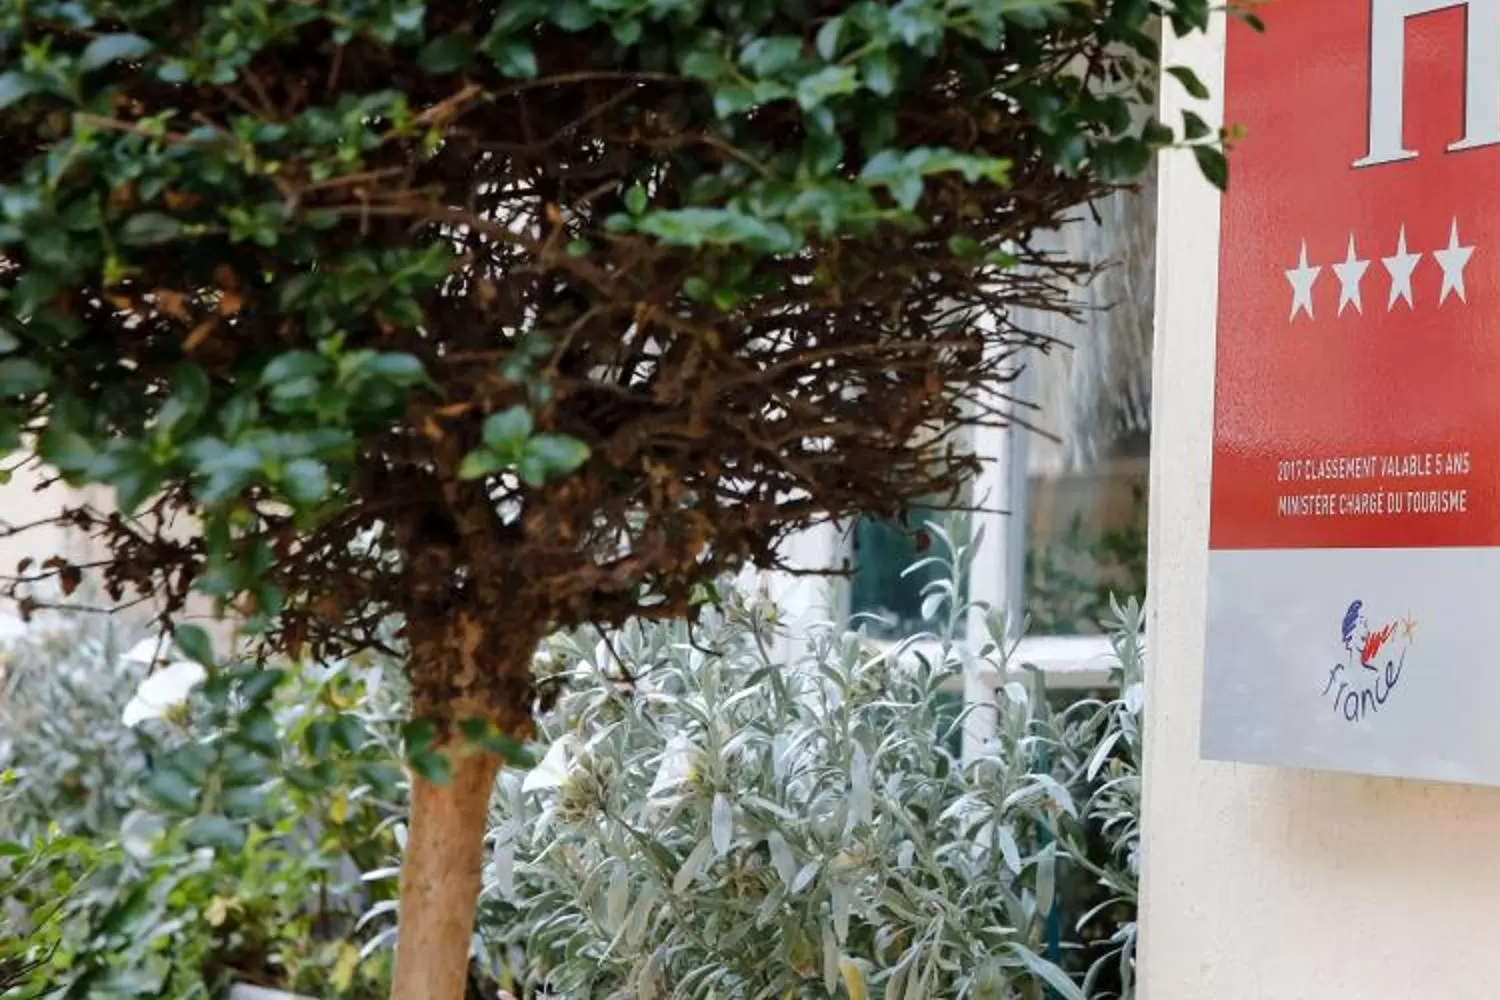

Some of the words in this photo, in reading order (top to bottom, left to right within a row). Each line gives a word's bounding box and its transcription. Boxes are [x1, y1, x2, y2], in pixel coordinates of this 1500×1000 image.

[1277, 460, 1301, 481] 2017
[1305, 456, 1376, 480] CLASSEMENT
[1380, 453, 1432, 477] VALABLE
[1435, 453, 1442, 475] 5
[1445, 452, 1471, 474] ANS
[1339, 486, 1384, 515] CHARGÉ
[1387, 491, 1402, 513] DU
[1407, 489, 1468, 513] TOURISME
